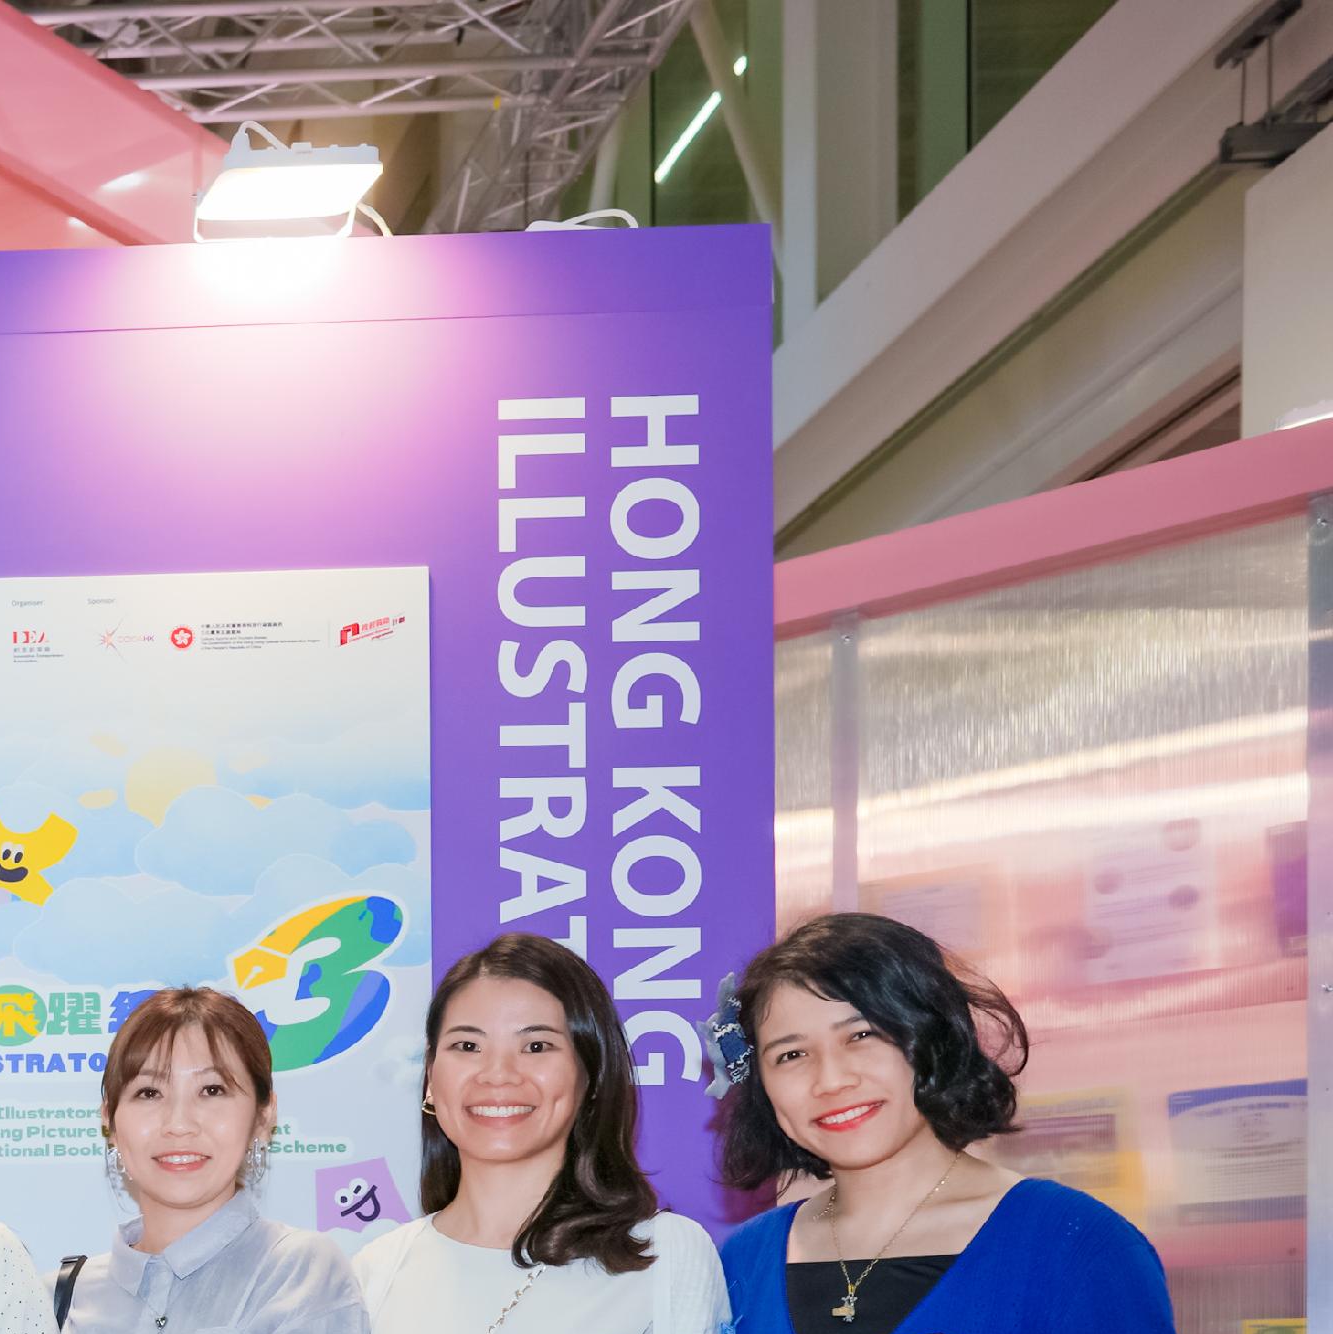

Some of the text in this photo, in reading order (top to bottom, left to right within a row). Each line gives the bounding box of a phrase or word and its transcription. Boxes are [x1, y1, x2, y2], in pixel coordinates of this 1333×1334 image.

[610, 394, 703, 1086] HONG KONG
[26, 1124, 98, 1139] Picture
[53, 1143, 103, 1157] Book
[268, 1140, 347, 1154] Scheme
